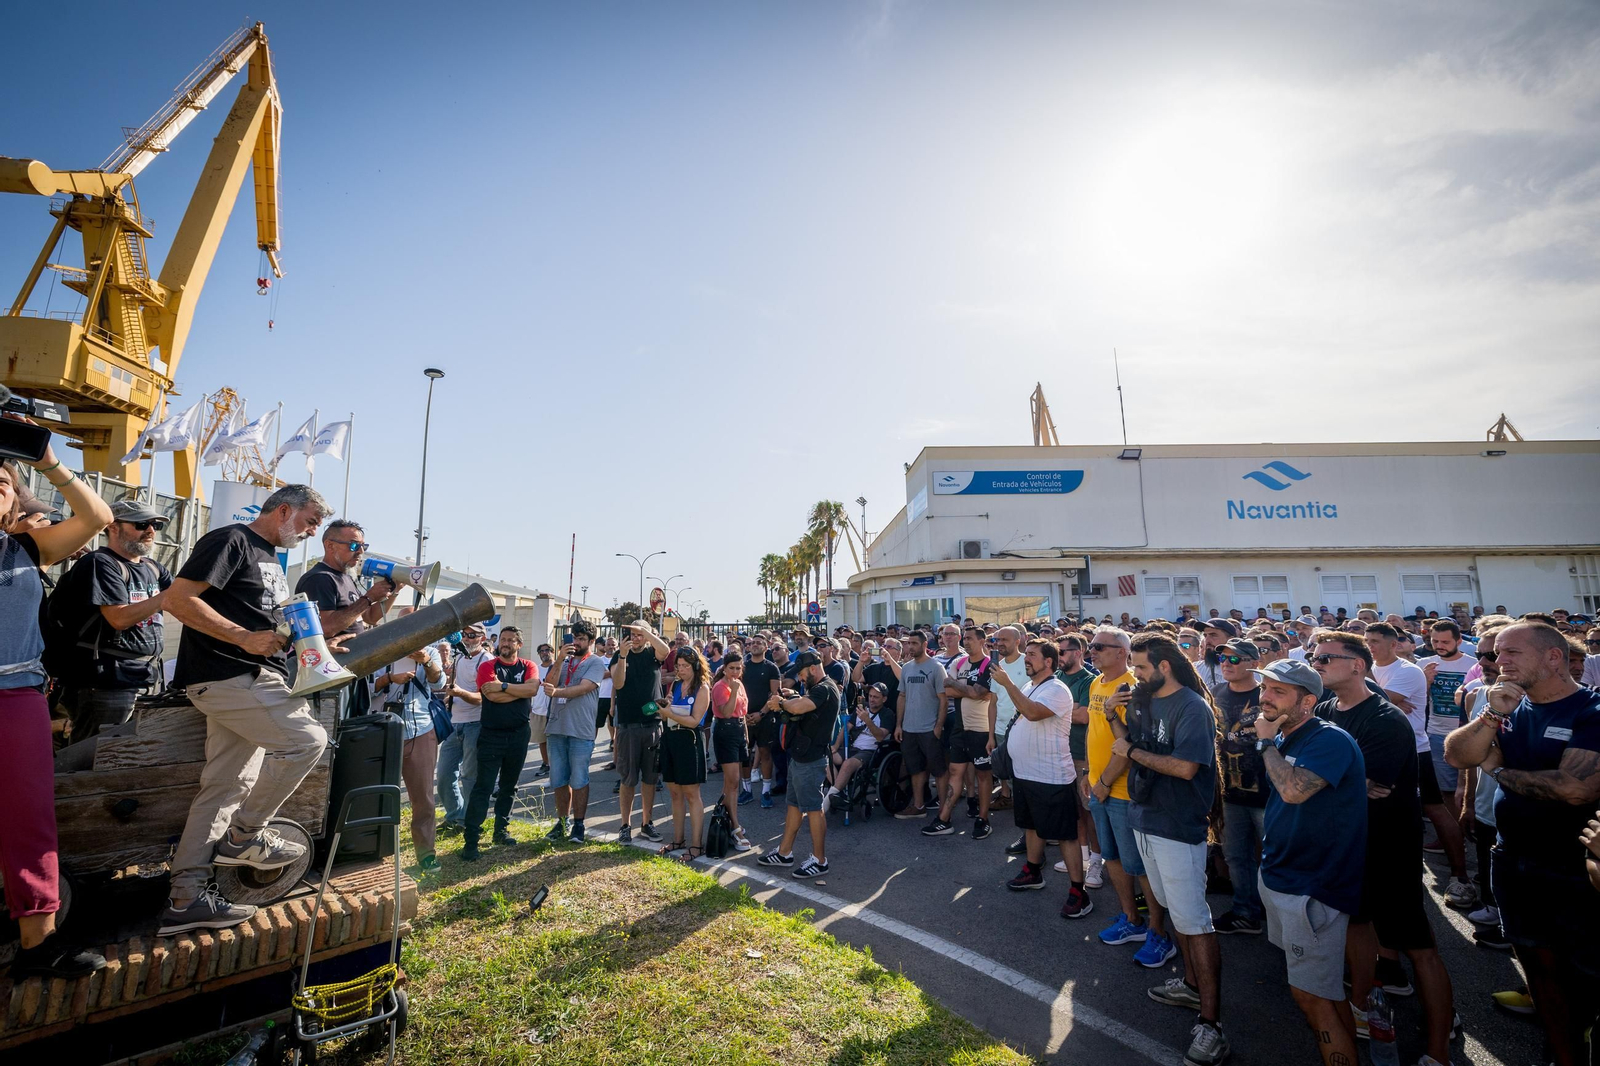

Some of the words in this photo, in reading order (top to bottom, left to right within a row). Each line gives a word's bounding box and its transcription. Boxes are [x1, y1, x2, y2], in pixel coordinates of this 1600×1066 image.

[1030, 480, 1062, 488] Vehículos
[1227, 499, 1338, 520] Navantia
[907, 676, 926, 684] PUMA
